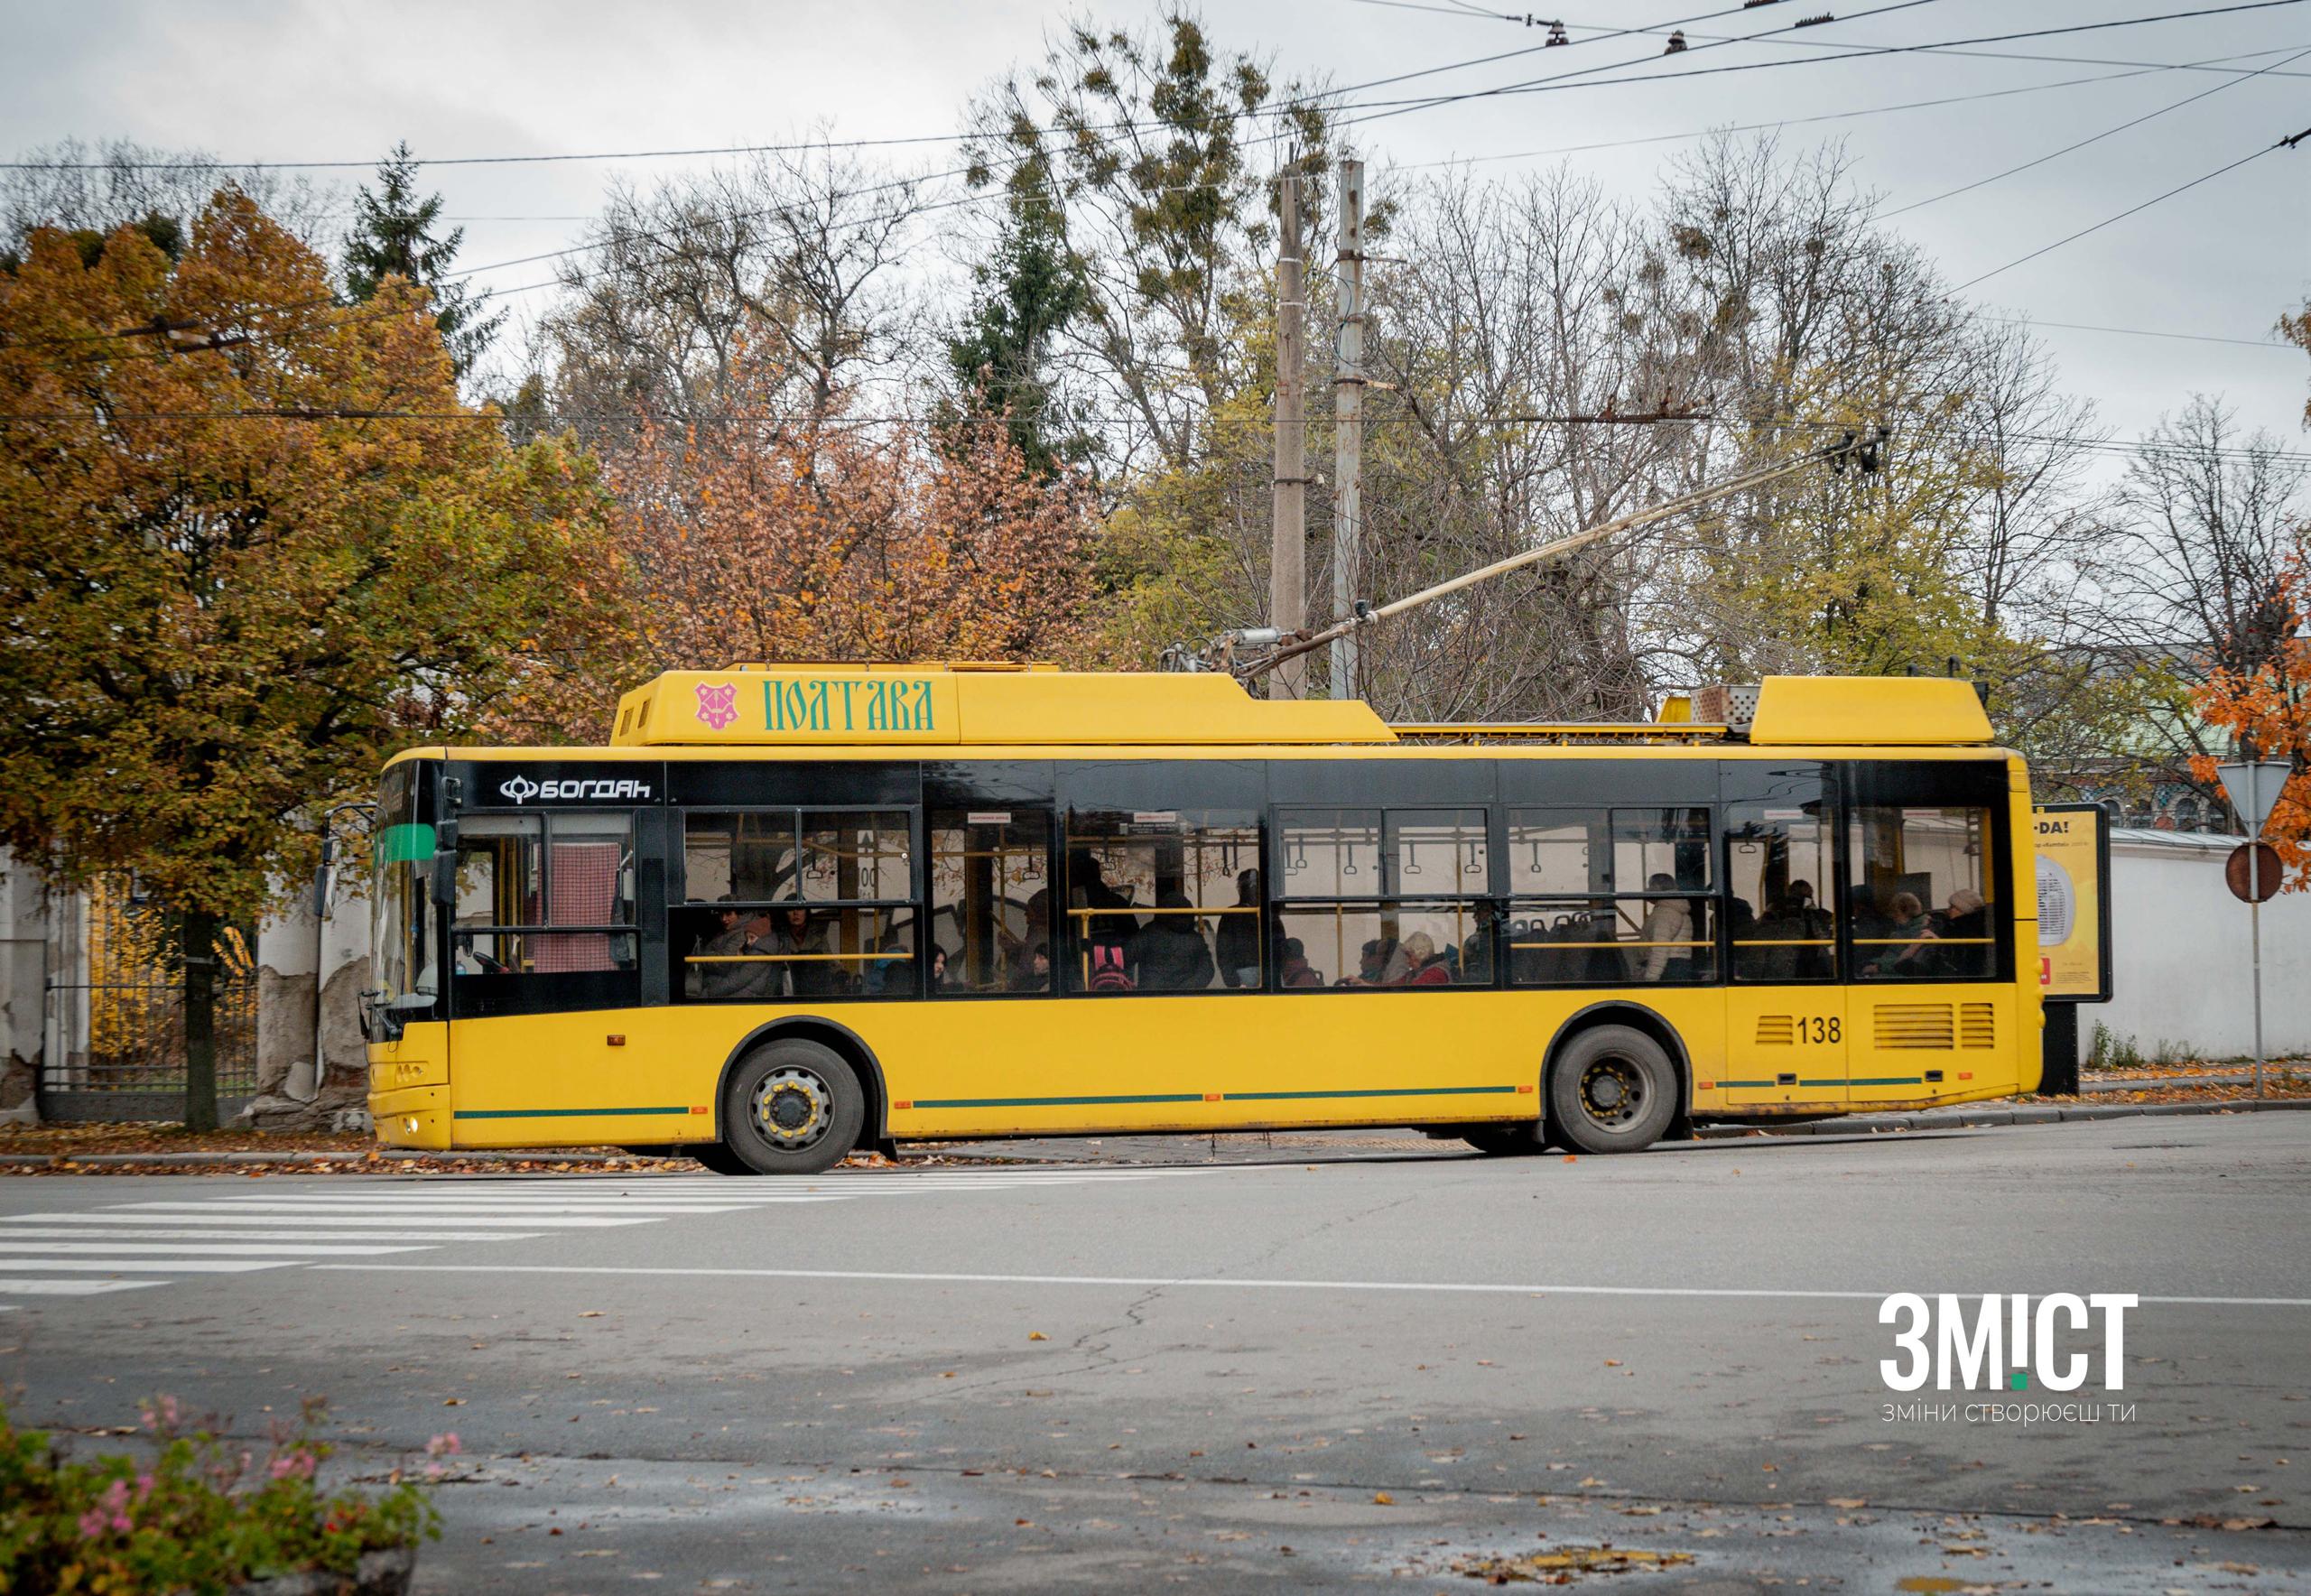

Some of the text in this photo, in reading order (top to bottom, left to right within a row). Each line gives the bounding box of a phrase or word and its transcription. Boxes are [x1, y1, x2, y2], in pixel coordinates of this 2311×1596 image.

[763, 680, 935, 731] ПОЛТАВА
[540, 779, 651, 799] БОГДАН
[1797, 1016, 1841, 1044] 138
